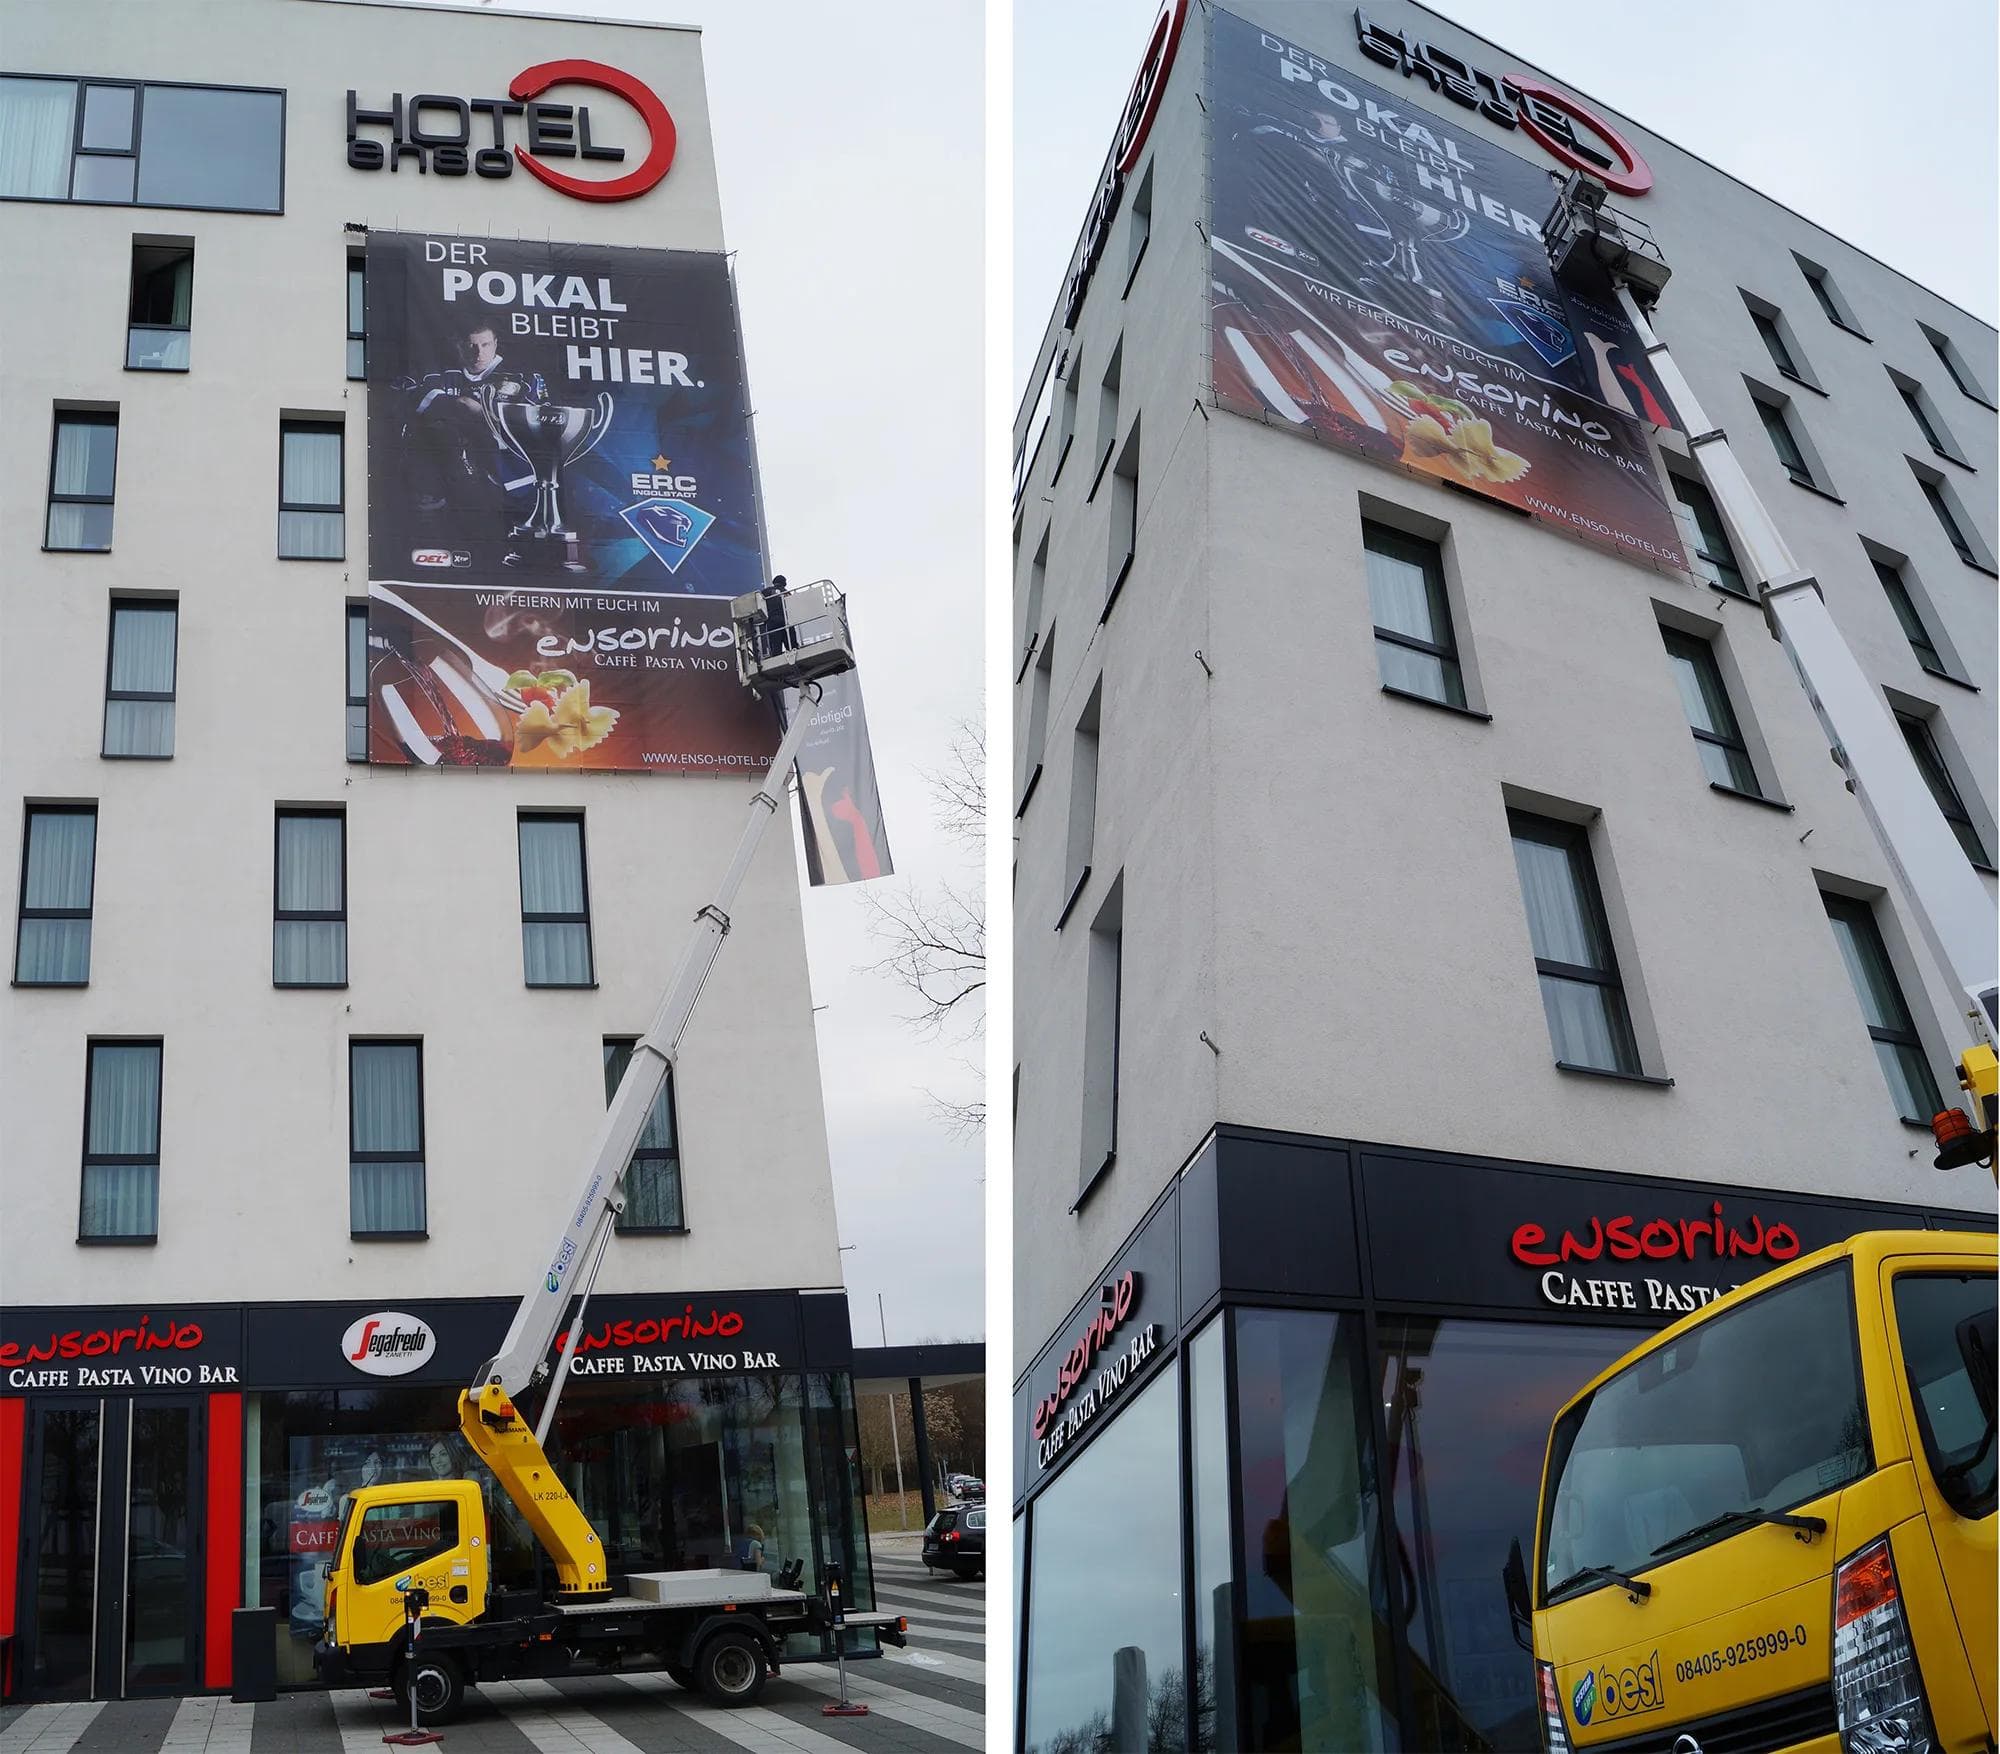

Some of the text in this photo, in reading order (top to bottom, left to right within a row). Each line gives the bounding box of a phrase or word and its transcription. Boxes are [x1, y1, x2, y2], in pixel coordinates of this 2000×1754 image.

[1260, 33, 1329, 77] DER
[1353, 4, 1613, 171] HOTEL
[346, 88, 626, 163] HOTEL
[1279, 57, 1475, 171] POKAL
[347, 140, 514, 179] enso
[1355, 117, 1470, 181] BLEIBT
[425, 240, 489, 266] DER
[442, 267, 628, 313] POKAL
[1495, 276, 1567, 317] ERC
[511, 312, 620, 340] BLEIBT
[1303, 280, 1527, 383] WIR FEIERN MIT EUCH IM
[566, 344, 705, 389] HIER.
[1382, 348, 1612, 442] ensorino
[1514, 411, 1563, 441] PASTA
[1566, 433, 1611, 459] VINO
[1615, 454, 1647, 476] BAR
[631, 473, 697, 492] ERC
[632, 489, 698, 499] INGOLSTADT
[1524, 494, 1681, 564] WWW.ENSO-HOTEL.DE
[475, 593, 660, 613] WIR FEIERN MIT EUCH IM
[536, 616, 736, 658] ensorino
[594, 652, 637, 667] CAFFÈ
[645, 655, 685, 670] PASTA
[691, 657, 728, 671] VINO
[641, 752, 775, 767] WWW.ENSO-HOTEL.DE
[1511, 1199, 1801, 1267] ensorino
[1540, 1270, 1638, 1310] CAFFE
[0, 1314, 204, 1368] ensorino
[351, 1321, 427, 1361] Segafredo
[555, 1303, 744, 1354] ensorino
[8, 1364, 240, 1388] CAFFE PASTA VINO BAR
[570, 1350, 781, 1375] CAFFE PASTA VINO BAR
[1032, 1269, 1135, 1441] ensorino
[1038, 1322, 1156, 1470] CAFFE PASTA VINO BAR
[533, 1491, 545, 1501] LK
[296, 1528, 338, 1546] CAFF
[362, 1527, 397, 1543] ASTA
[1675, 1623, 1808, 1683] 08405-925999-0
[1598, 1647, 1666, 1717] besl
